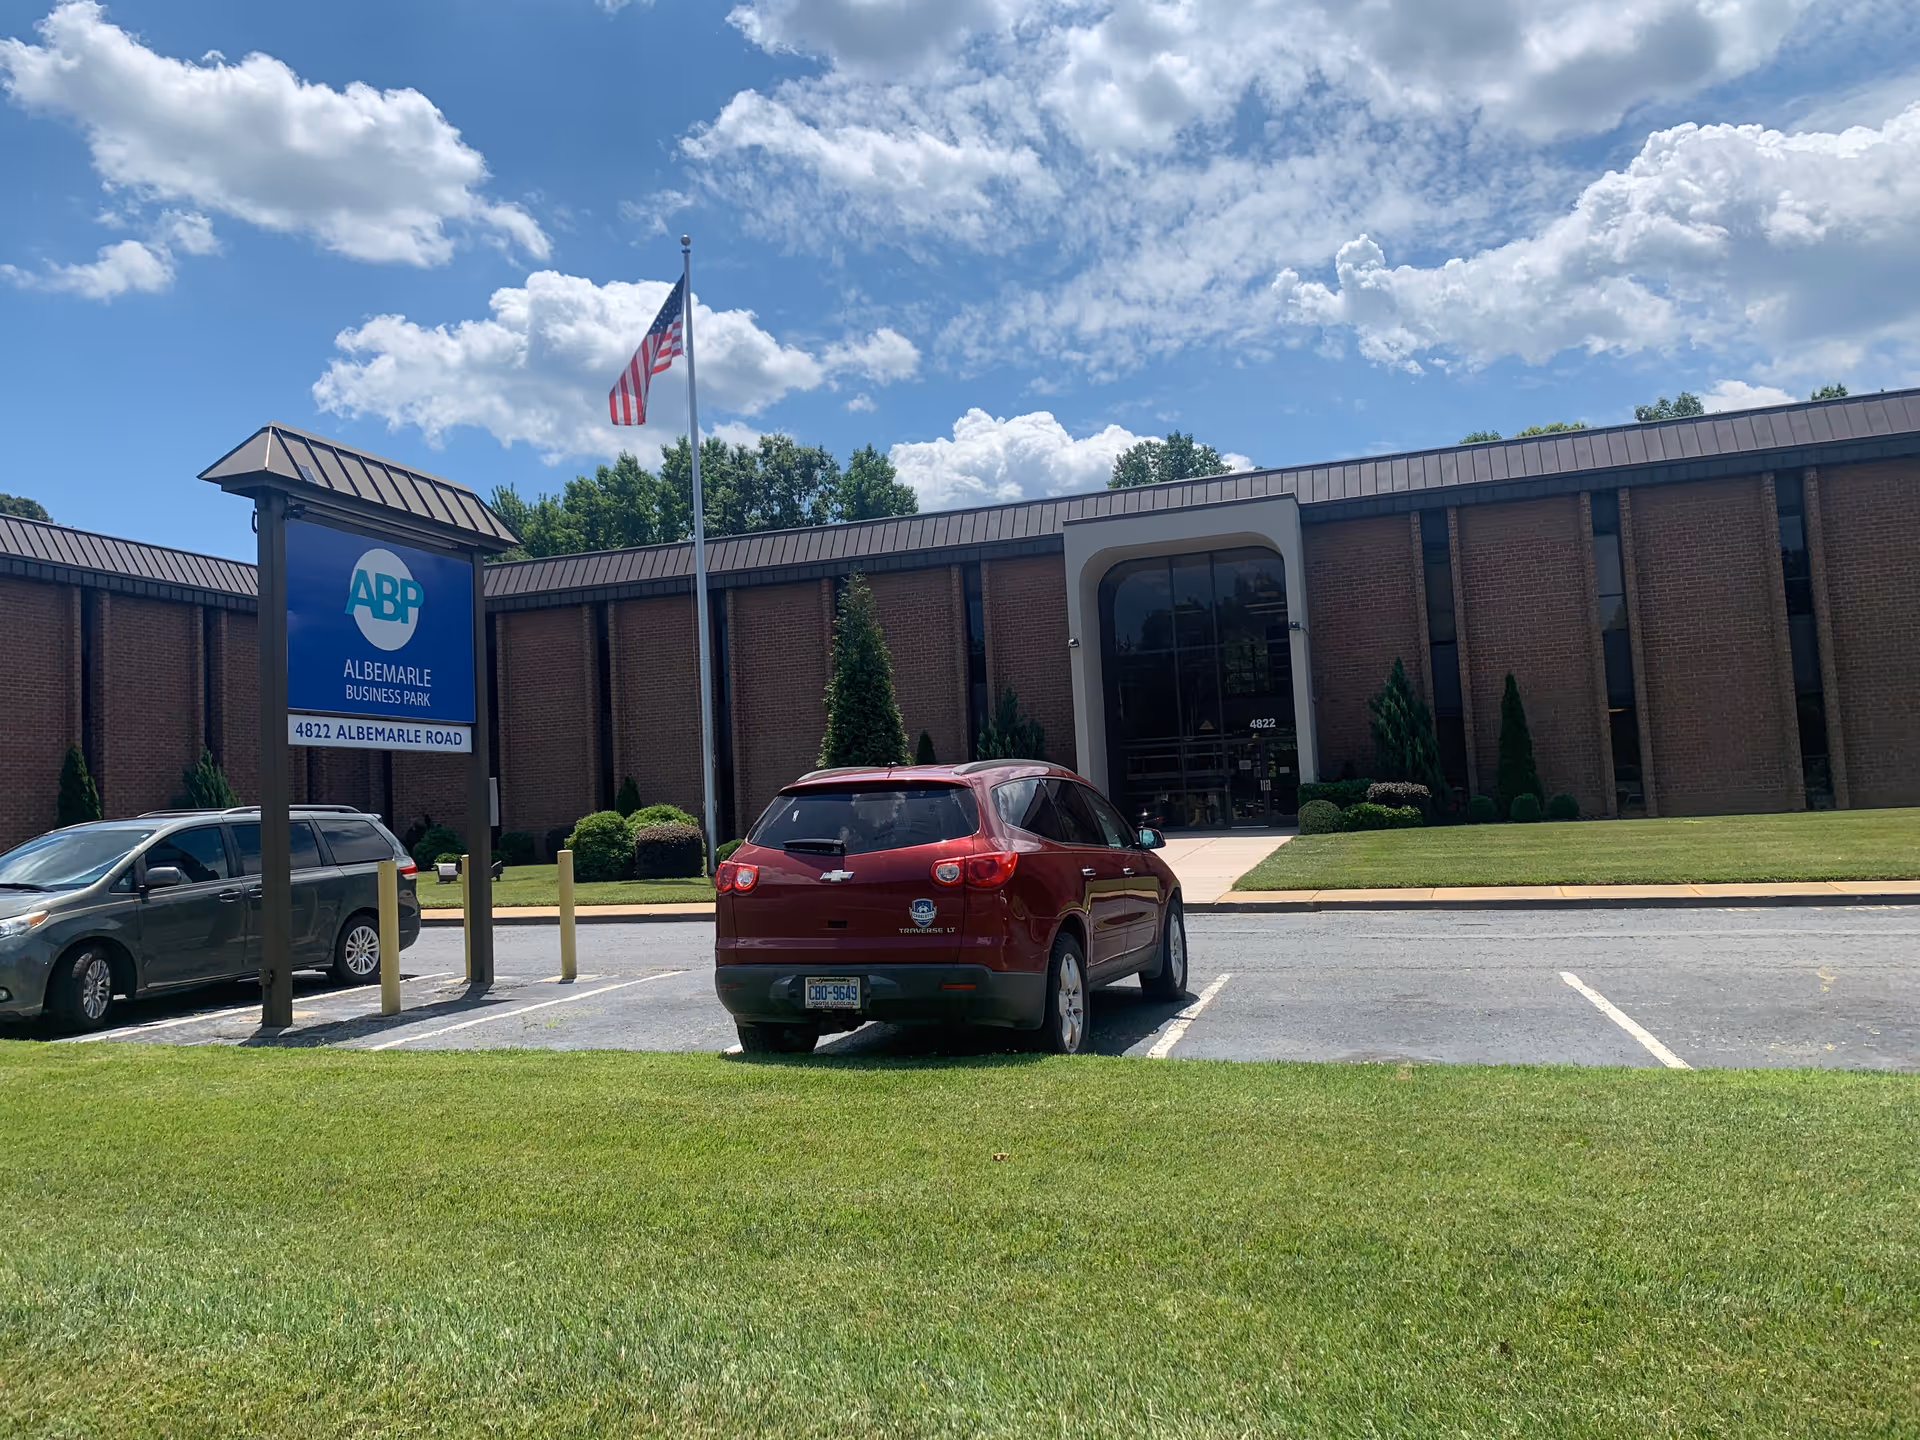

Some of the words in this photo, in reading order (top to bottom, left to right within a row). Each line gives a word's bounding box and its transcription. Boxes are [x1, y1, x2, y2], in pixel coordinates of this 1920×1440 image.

[344, 568, 425, 625] ABP
[343, 659, 432, 688] ALBEMARLE
[345, 684, 401, 705] BUSINESS
[403, 690, 431, 707] PARK
[295, 722, 331, 739] 4822
[336, 724, 422, 744] ALBEMARLE
[425, 730, 463, 746] ROAD
[1250, 718, 1276, 729] 4822
